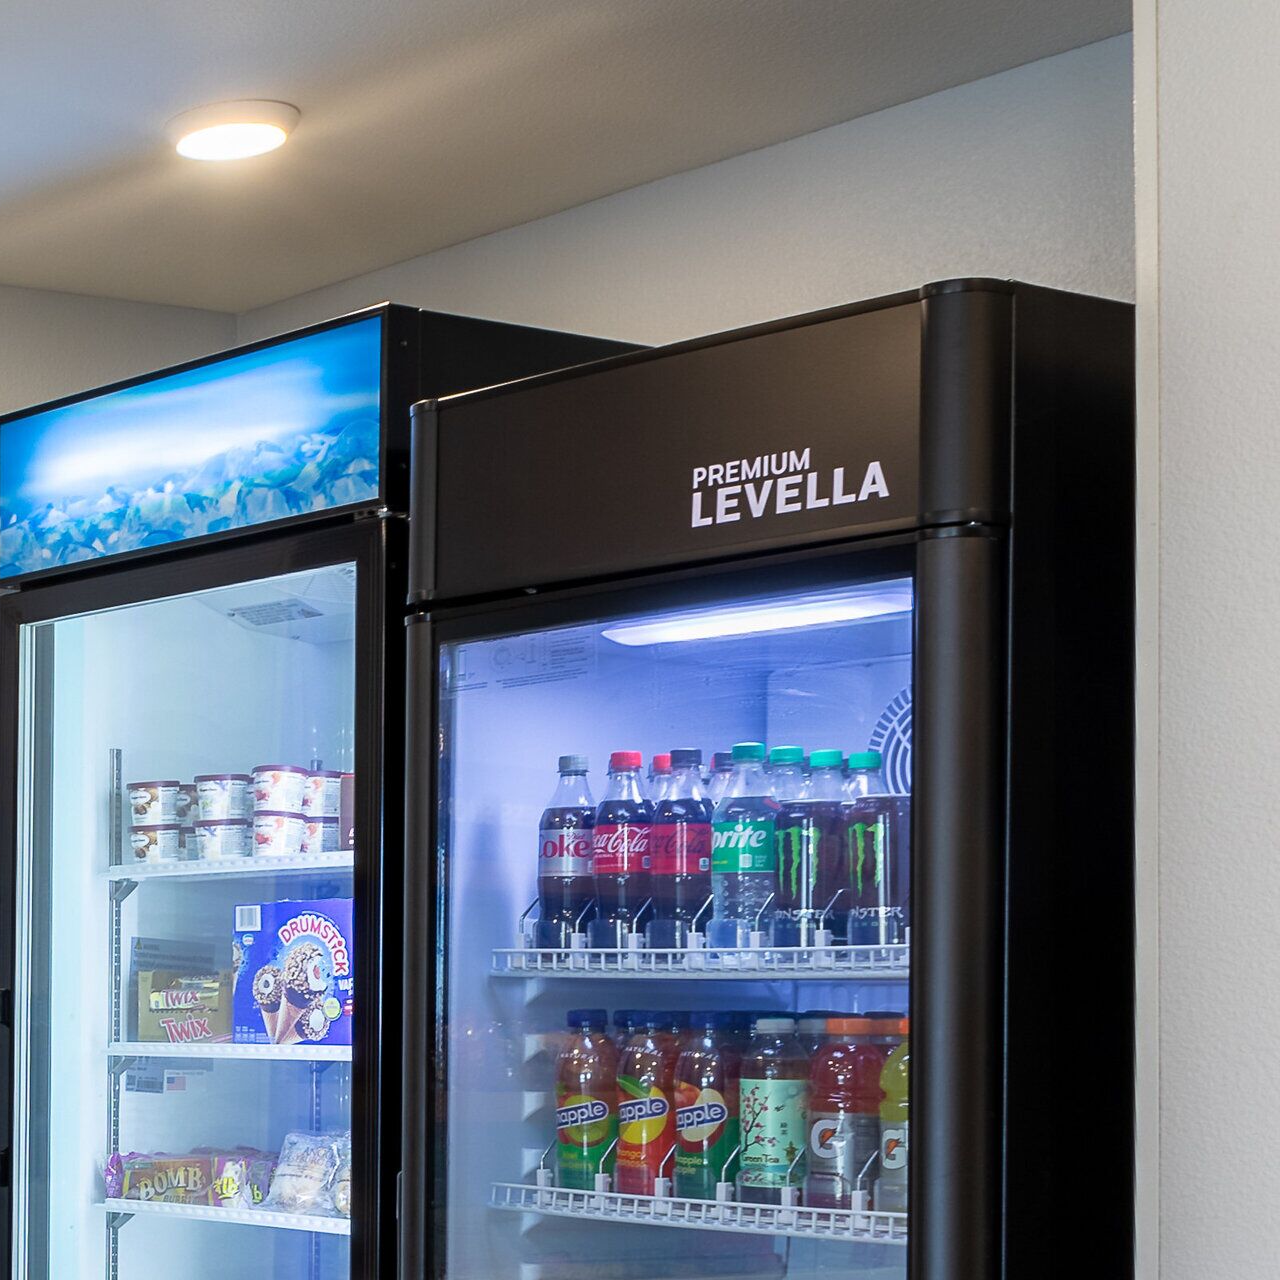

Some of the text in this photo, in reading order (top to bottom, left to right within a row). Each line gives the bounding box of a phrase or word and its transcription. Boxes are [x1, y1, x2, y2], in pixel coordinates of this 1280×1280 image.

[692, 447, 811, 489] PREMIUM
[691, 460, 890, 528] LEVELLA
[711, 823, 767, 855] prite
[163, 989, 200, 1009] Twix
[160, 1015, 212, 1043] Twix
[620, 1099, 664, 1123] apple
[677, 1103, 722, 1127] apple
[138, 1166, 204, 1201] BOMB
